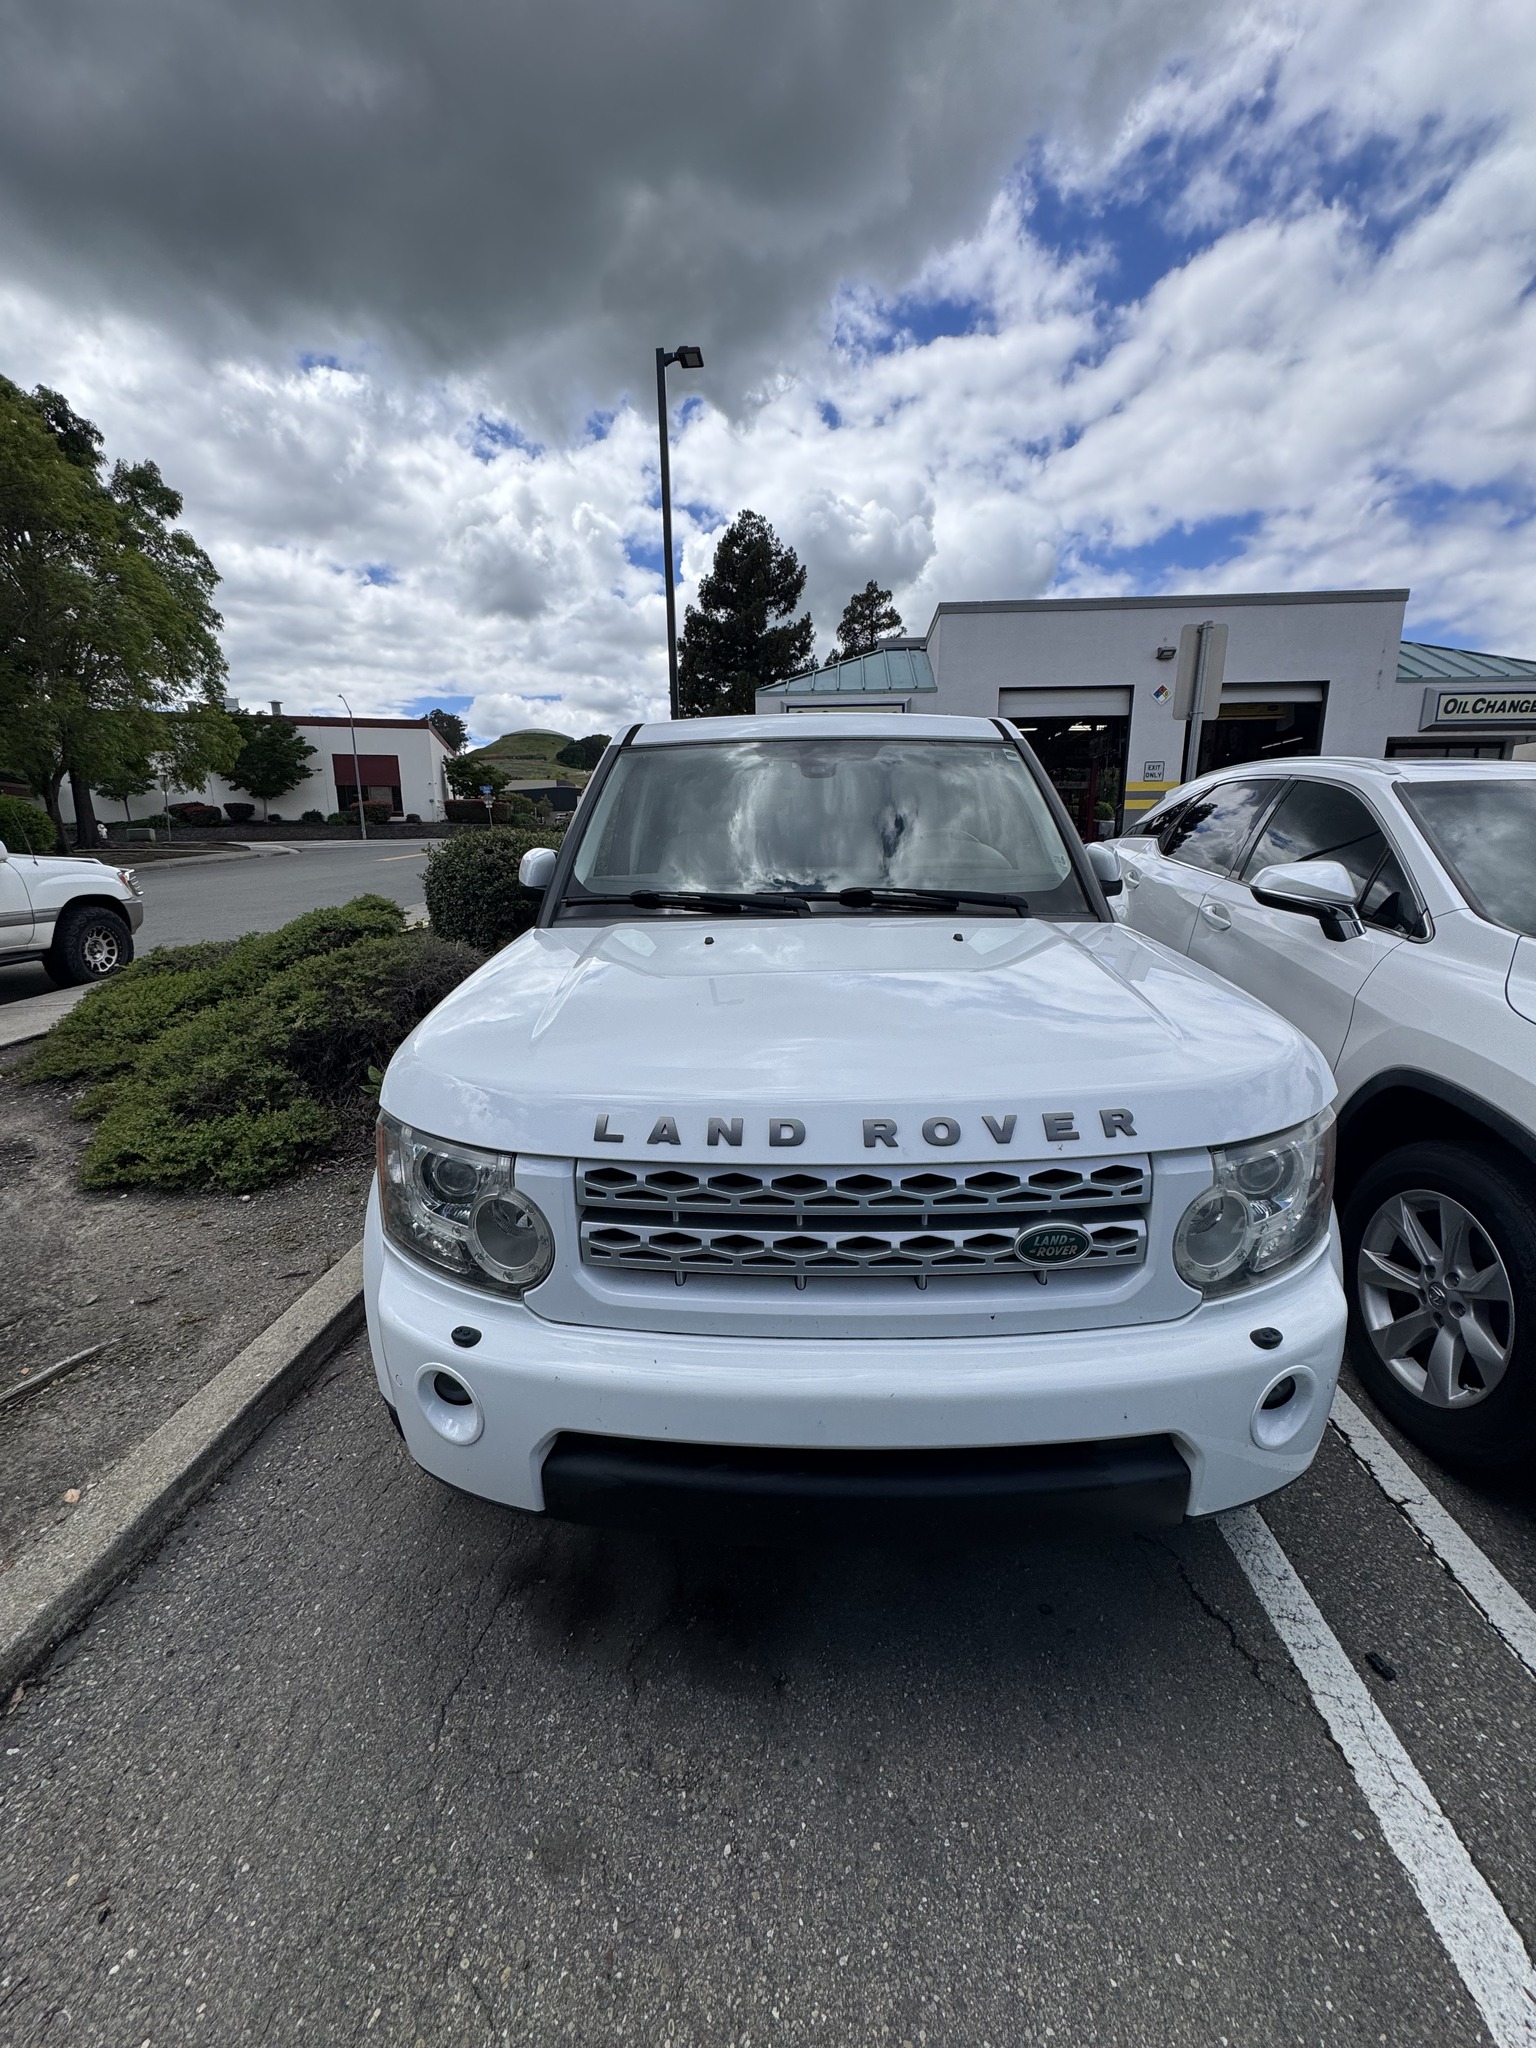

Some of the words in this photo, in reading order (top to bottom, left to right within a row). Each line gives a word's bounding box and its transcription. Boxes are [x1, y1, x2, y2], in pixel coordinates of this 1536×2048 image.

[1443, 698, 1470, 714] OIL
[593, 1113, 806, 1147] LAND
[862, 1108, 1138, 1147] ROVER
